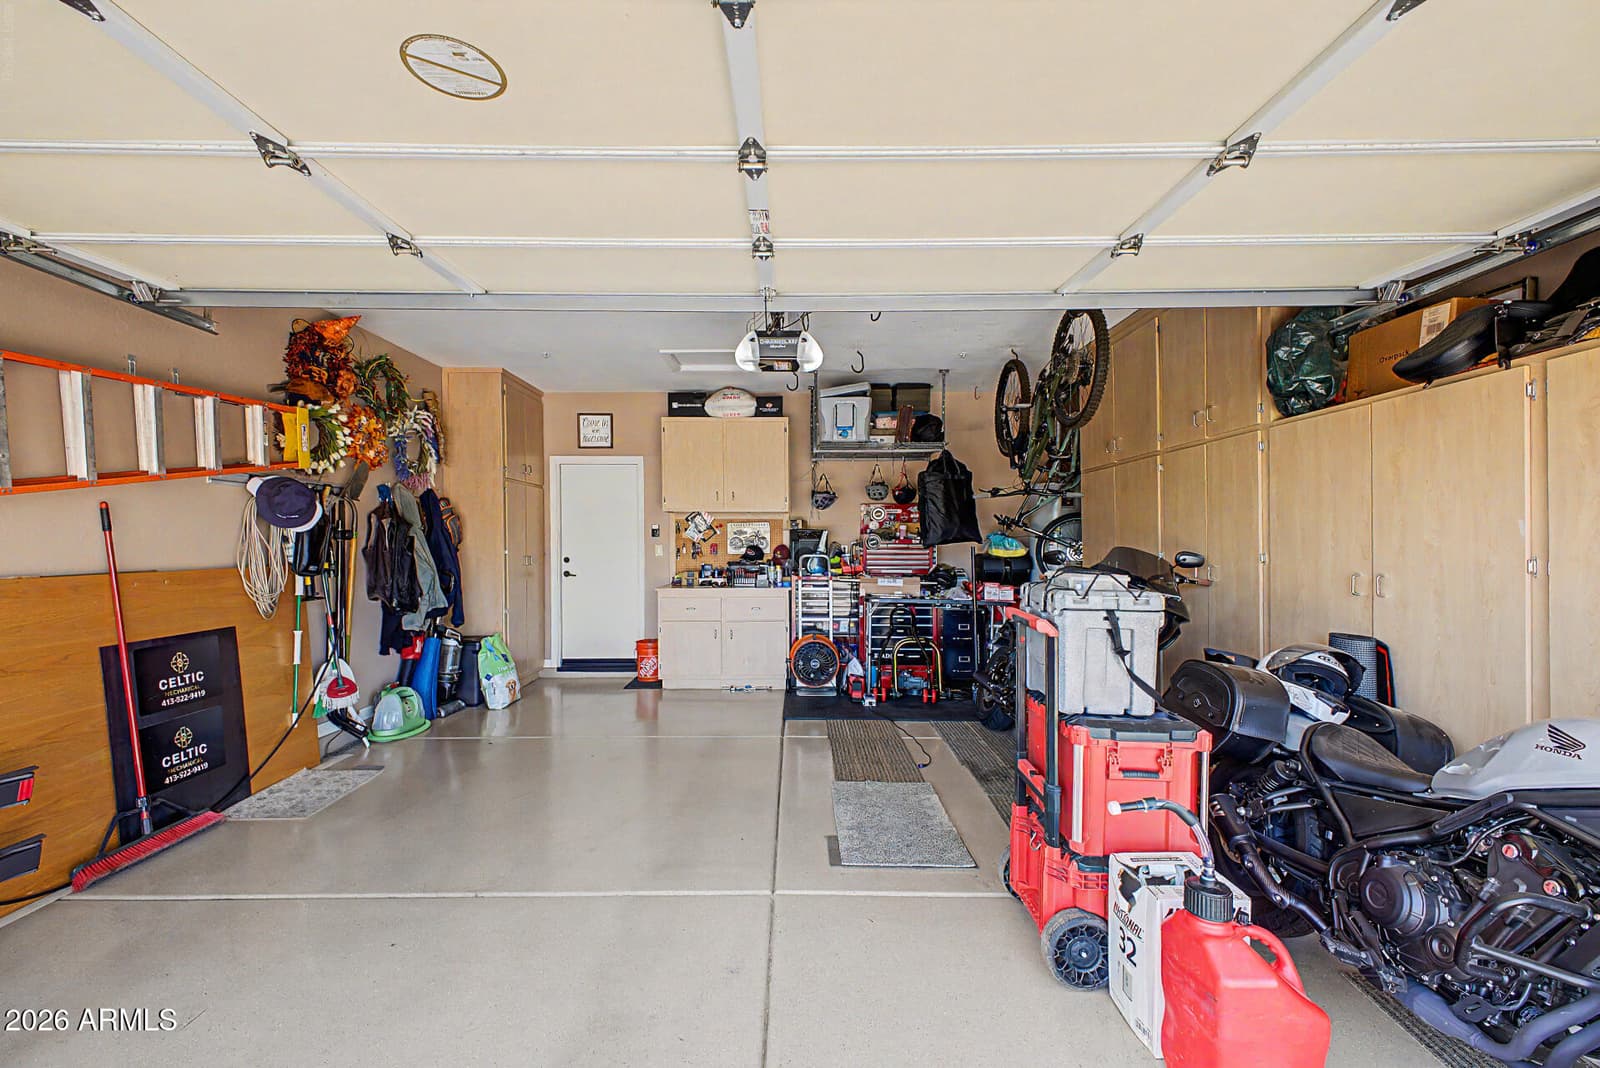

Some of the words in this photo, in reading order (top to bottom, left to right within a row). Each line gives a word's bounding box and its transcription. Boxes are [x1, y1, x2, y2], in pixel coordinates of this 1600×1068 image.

[158, 671, 205, 690] CELTIC
[161, 743, 208, 768] CELTIC
[1534, 743, 1583, 760] HONDA
[1119, 926, 1137, 967] 32
